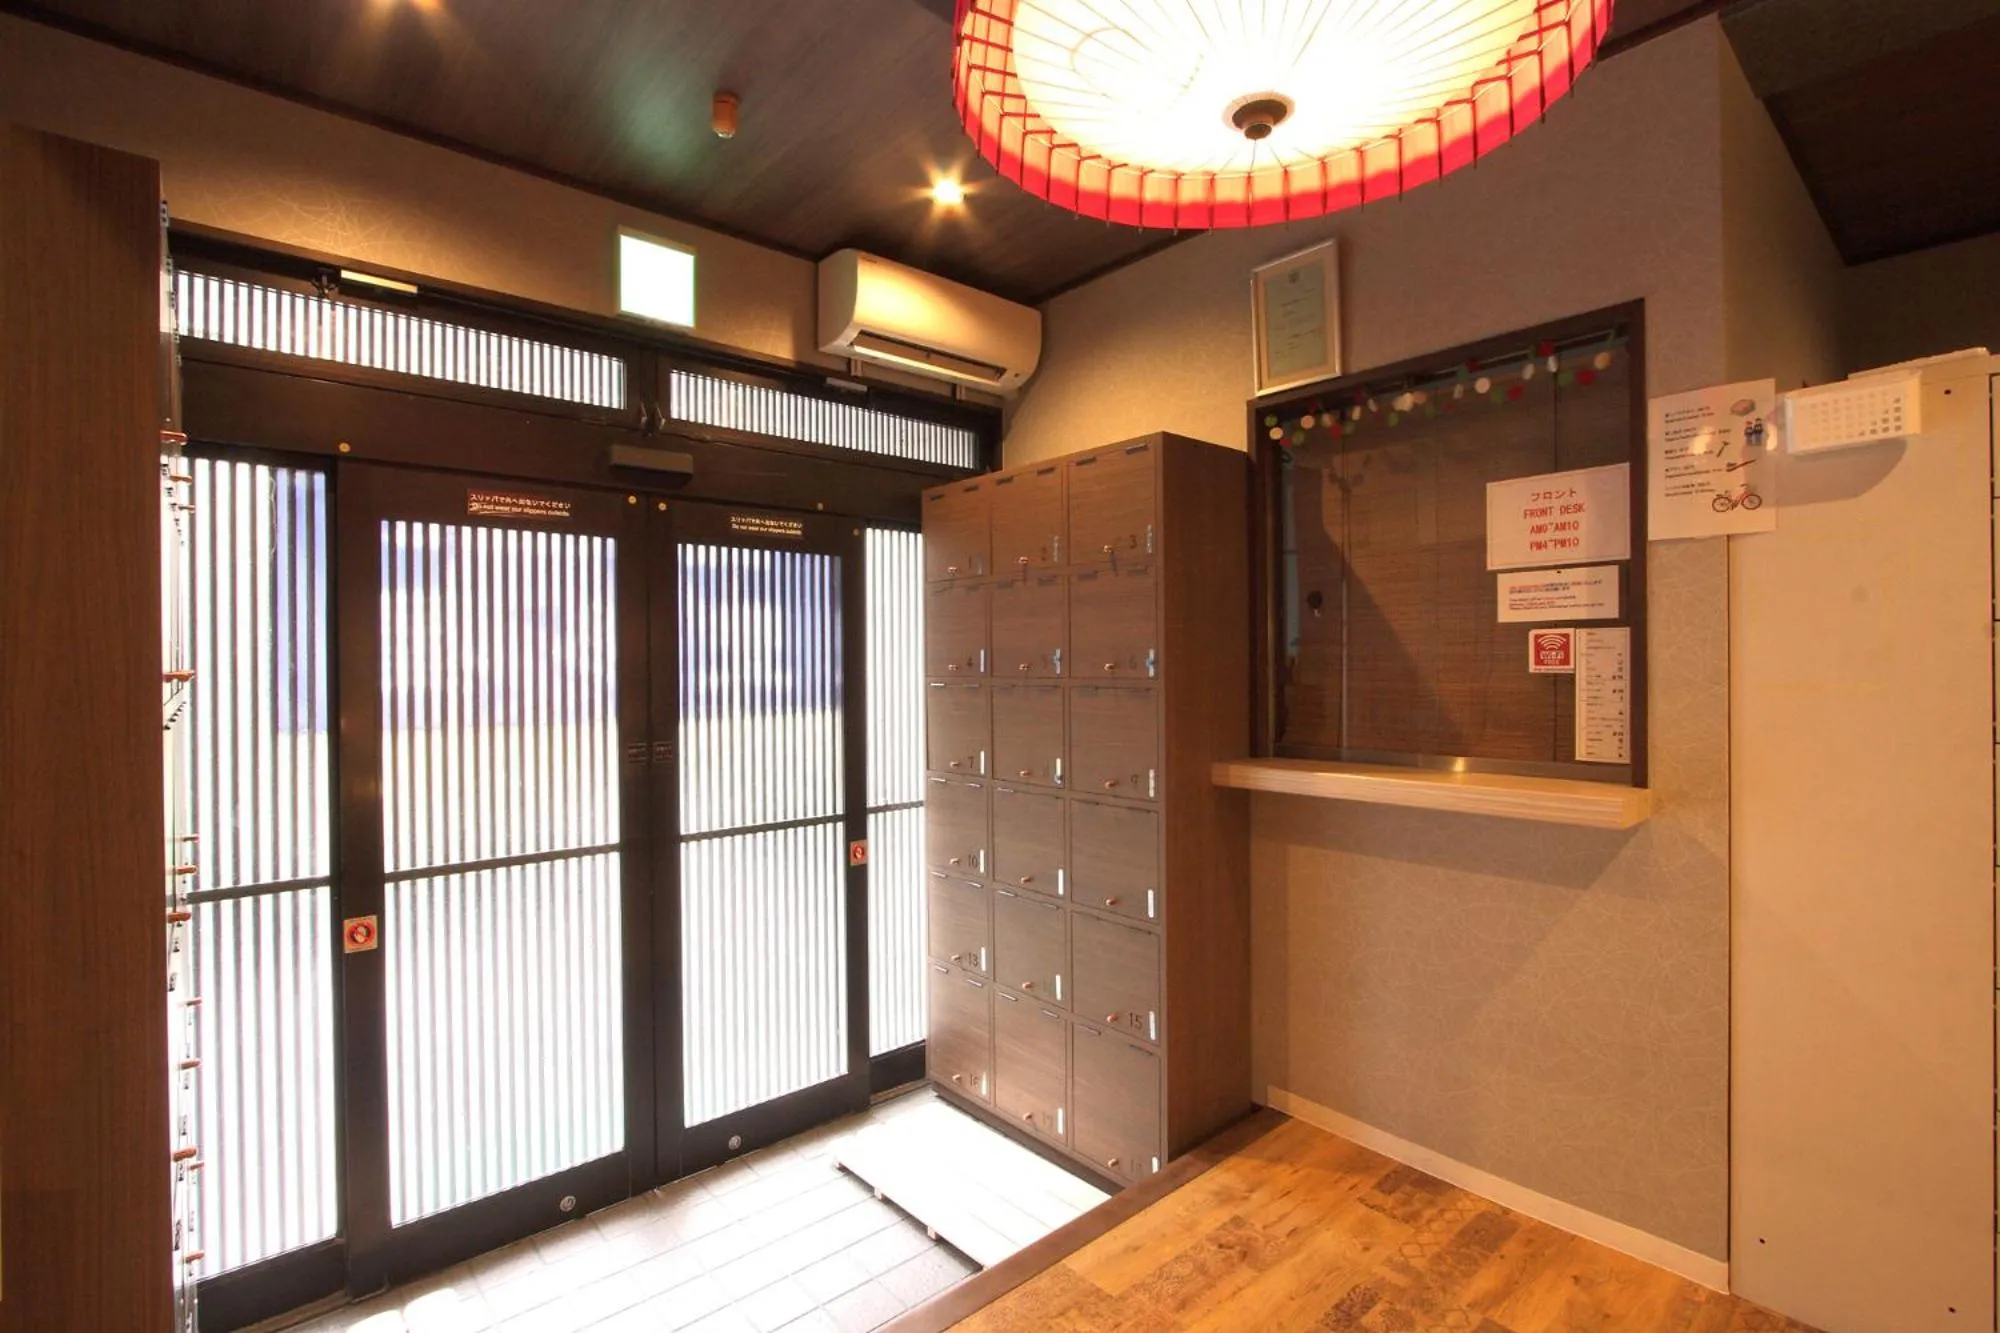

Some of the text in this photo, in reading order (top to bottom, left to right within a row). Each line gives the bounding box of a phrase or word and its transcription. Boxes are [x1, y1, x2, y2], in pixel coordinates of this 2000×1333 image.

[1531, 488, 1577, 502] フロント
[1523, 502, 1586, 519] FRONT DESK
[1129, 534, 1138, 550] 3
[967, 756, 974, 769] 7
[968, 854, 978, 869] 10
[968, 952, 978, 968] 13
[1129, 1012, 1143, 1030] 15
